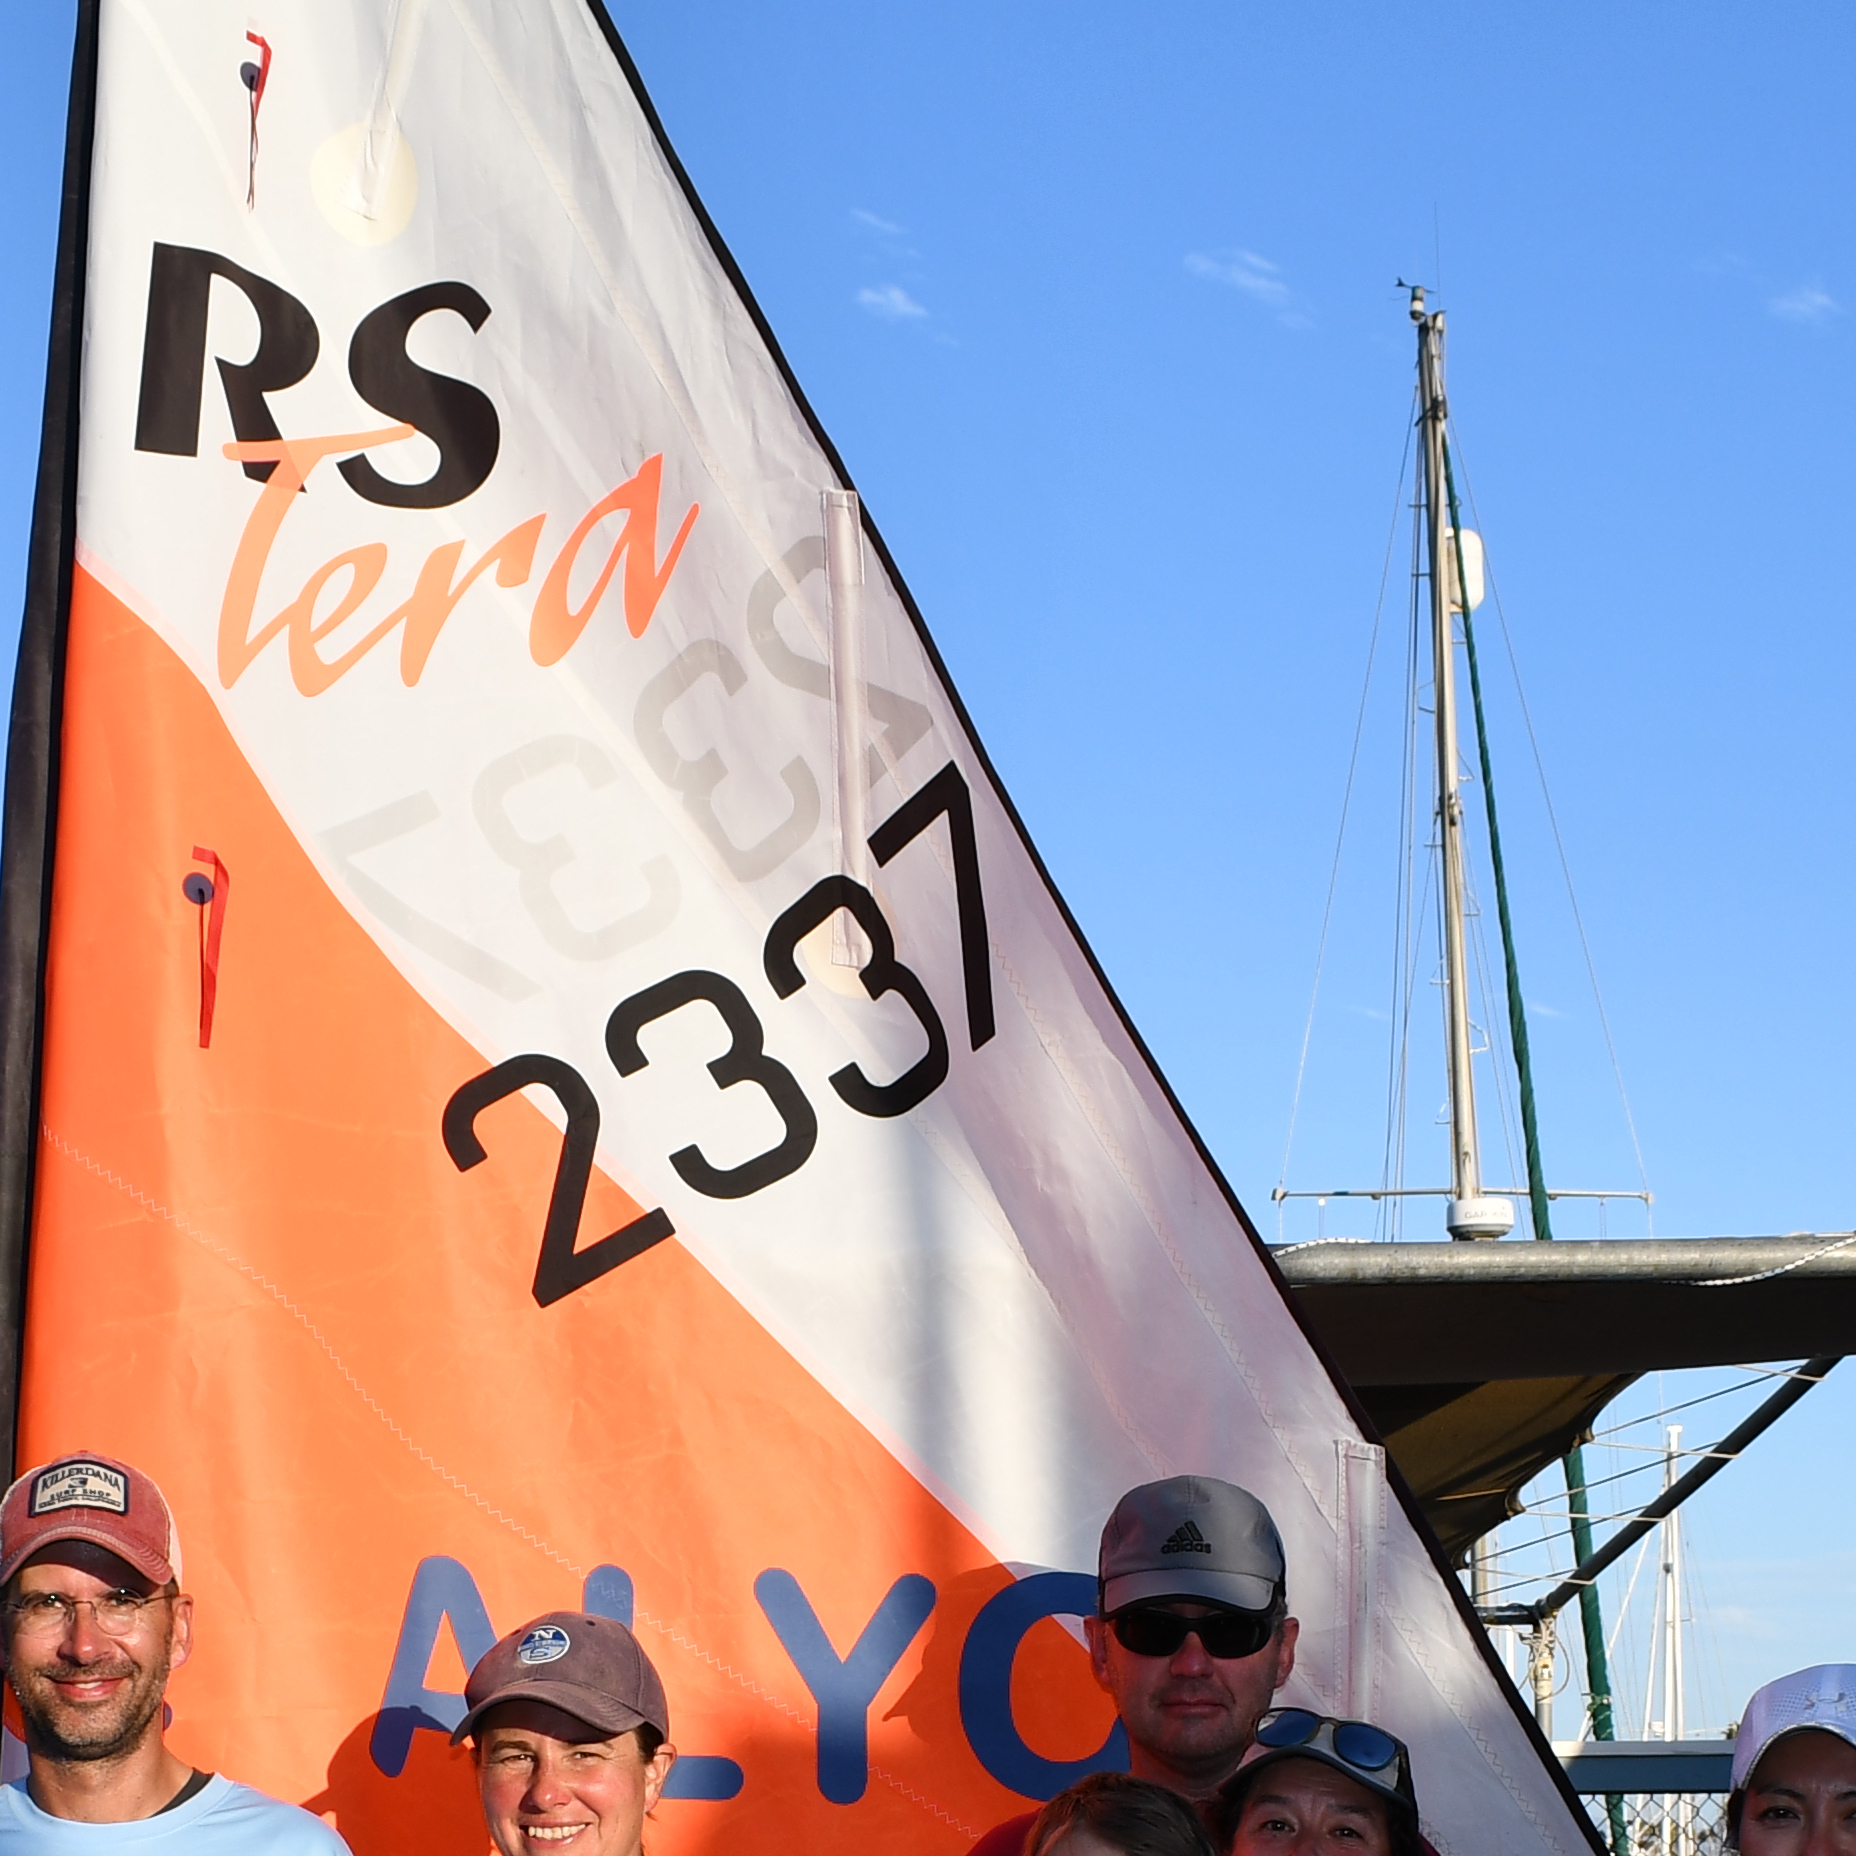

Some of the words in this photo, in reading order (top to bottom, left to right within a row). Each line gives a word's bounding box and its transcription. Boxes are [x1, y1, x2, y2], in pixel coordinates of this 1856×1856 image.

[134, 242, 501, 510] RS
[217, 424, 700, 698] Tera
[442, 760, 996, 1308] 2337
[1160, 1540, 1212, 1555] adidas
